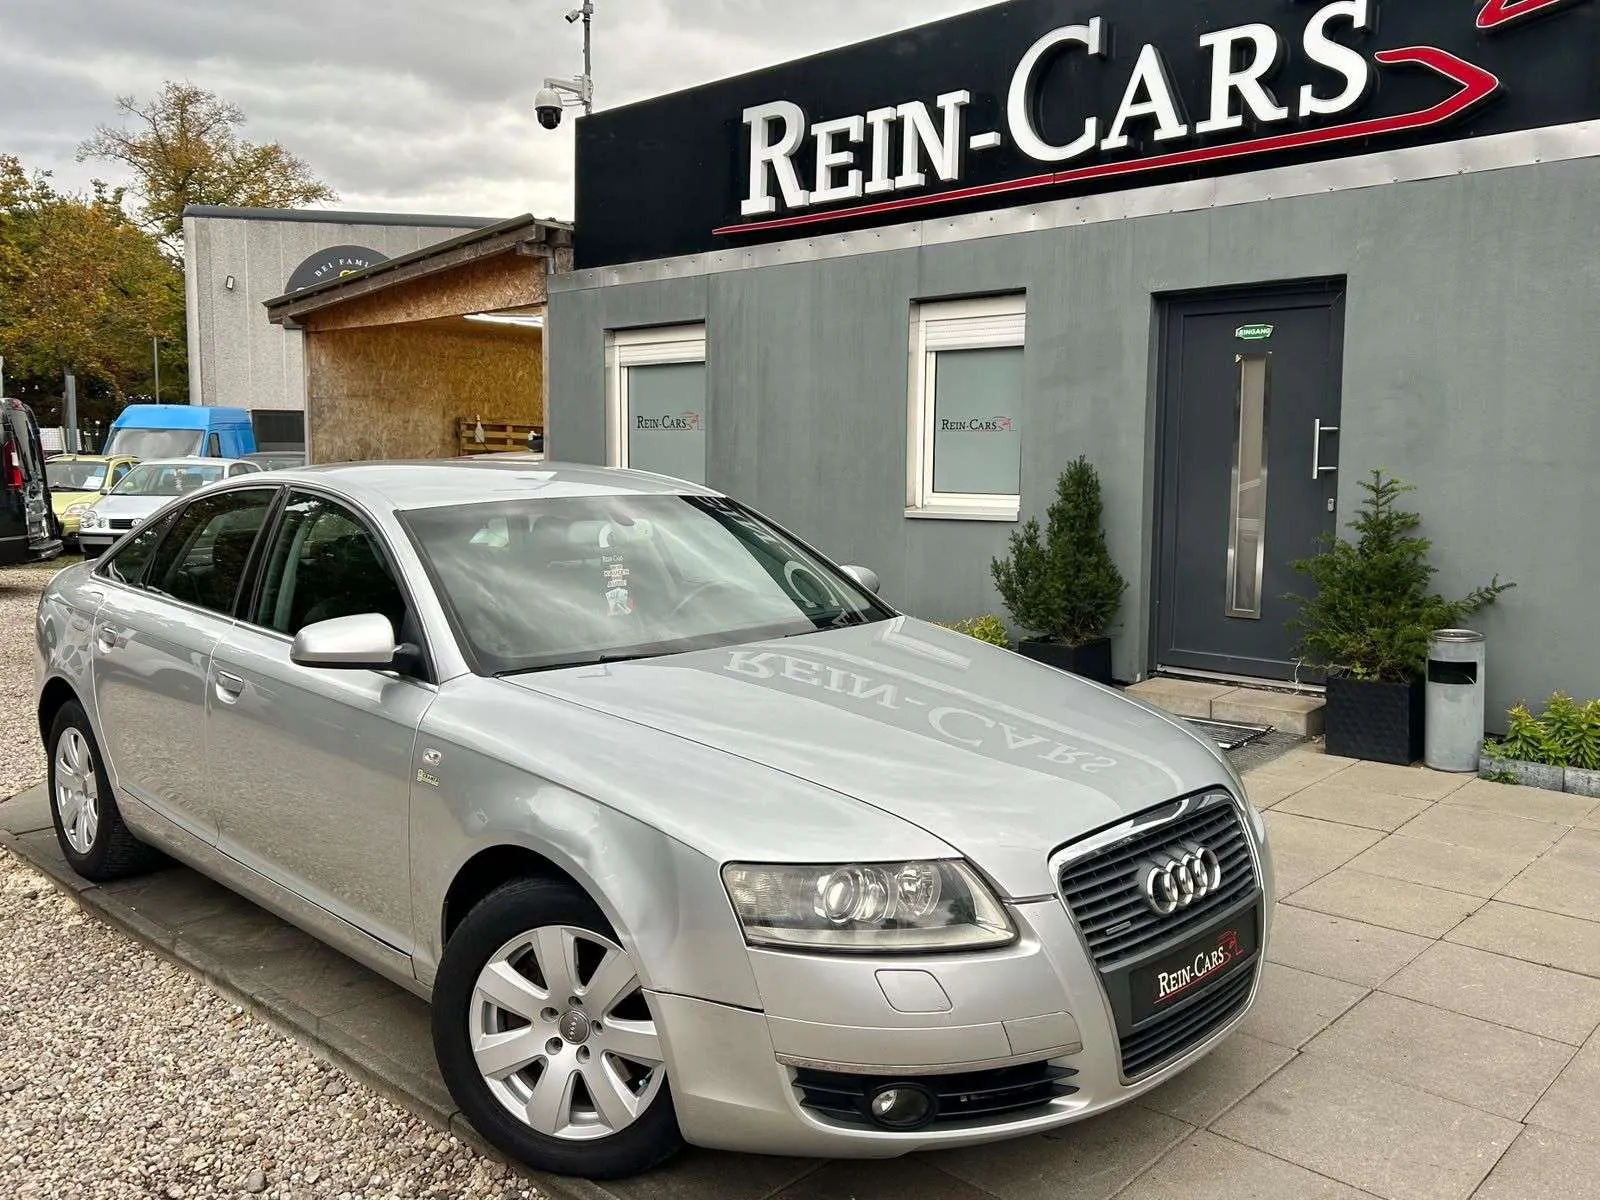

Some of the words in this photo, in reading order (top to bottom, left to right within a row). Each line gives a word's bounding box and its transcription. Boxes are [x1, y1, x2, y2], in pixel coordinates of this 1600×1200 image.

[741, 0, 1370, 216] REIN-CARS
[314, 262, 334, 277] BEI
[637, 415, 687, 429] REIN-CARS
[941, 418, 997, 430] REIN-CARS
[1157, 946, 1224, 997] REIN-CARS
